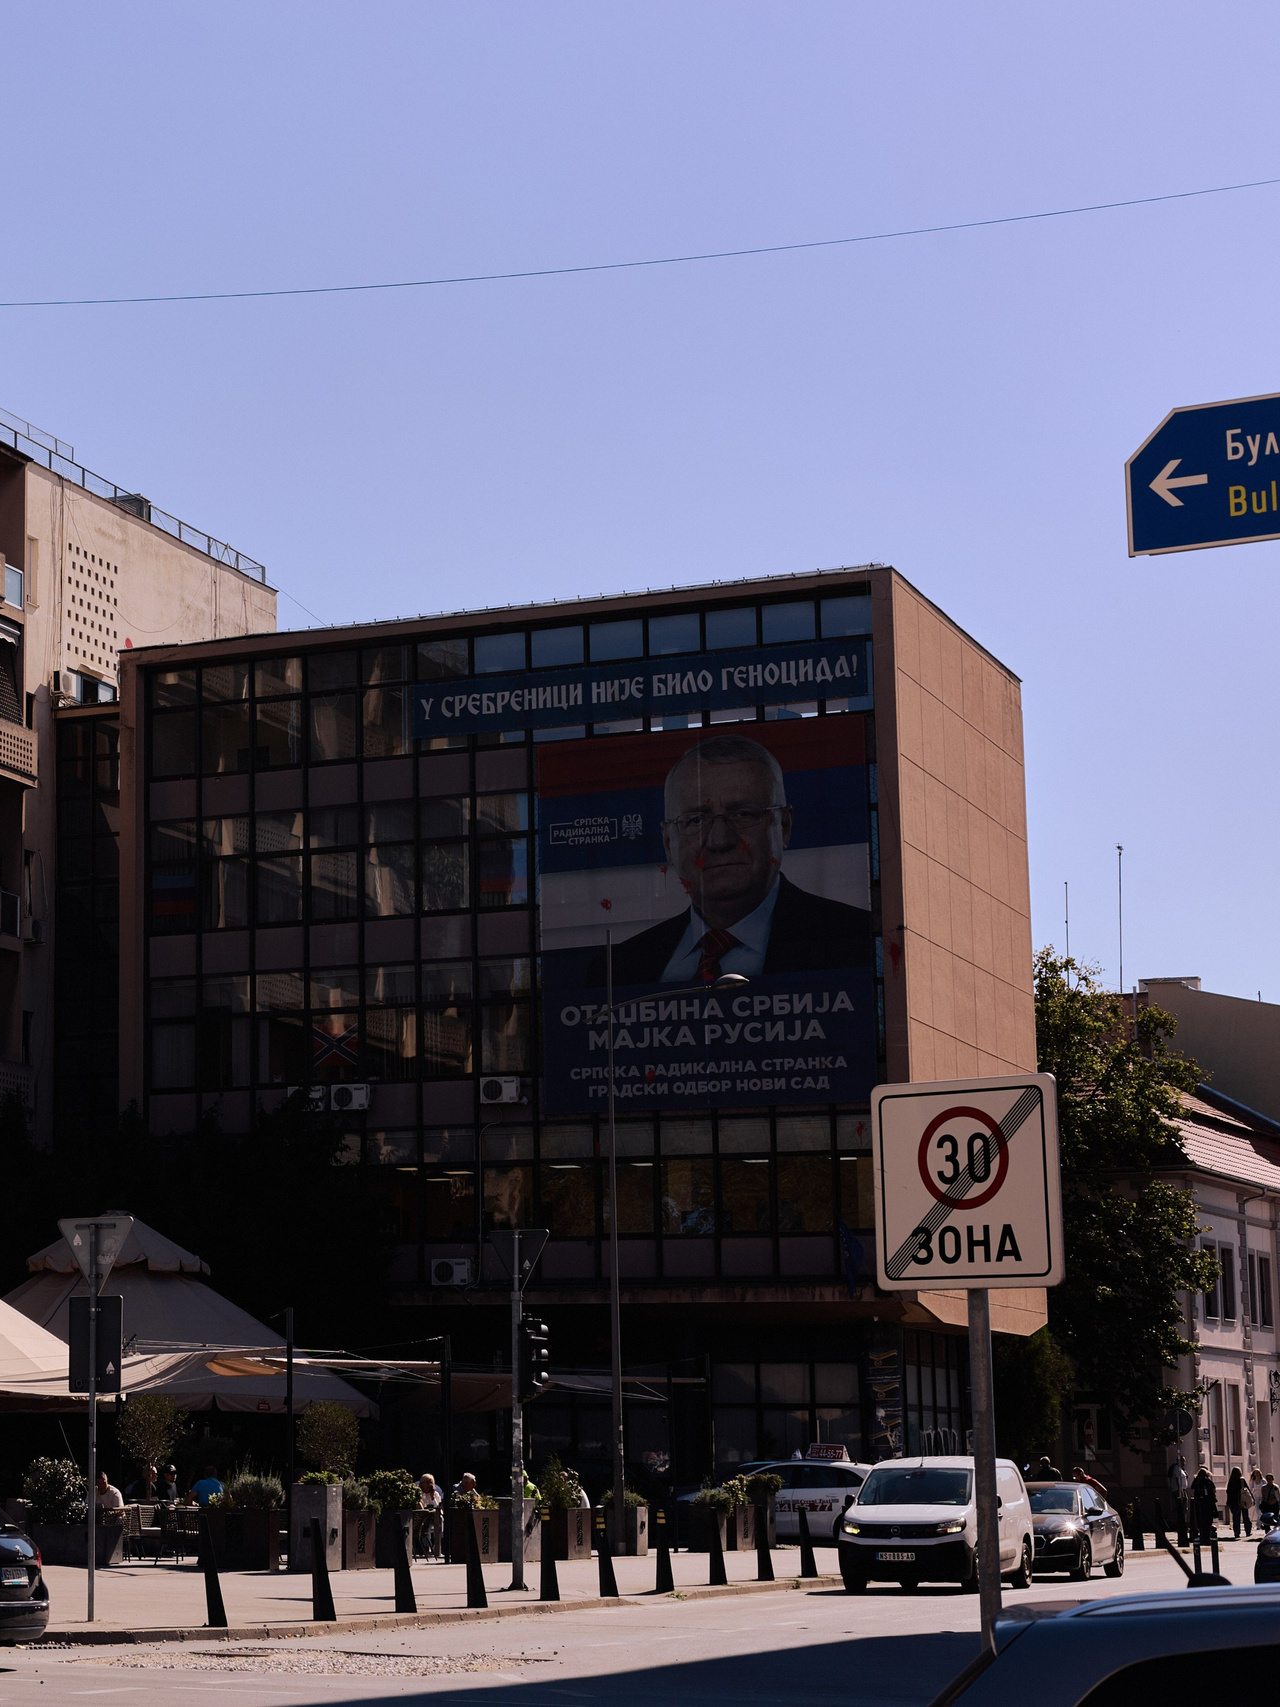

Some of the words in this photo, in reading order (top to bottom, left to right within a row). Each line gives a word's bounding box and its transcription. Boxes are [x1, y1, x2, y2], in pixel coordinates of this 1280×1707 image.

[1226, 428, 1279, 466] Бул
[1229, 480, 1277, 516] Bul
[421, 698, 433, 720] У
[441, 682, 582, 718] СРЕБРЕНИЦИ
[591, 676, 644, 704] НИЈЕ
[652, 669, 713, 697] БИЛО
[721, 654, 858, 691] ГЕНОЦИДА!
[553, 826, 610, 838] РАДИКАЛНА
[574, 817, 610, 827] СРПСКА
[568, 835, 610, 845] СТРАНКА
[560, 998, 724, 1026] ОТАЏБИНА
[732, 991, 855, 1017] СРБИЈА
[588, 1026, 696, 1051] МАЈКА
[704, 1019, 826, 1045] РУСИЈА
[570, 1065, 640, 1080] СРПСКА
[645, 1060, 757, 1077] РАДИКАЛНА
[761, 1056, 848, 1071] СТРАНКА
[588, 1082, 668, 1098] ГРАДСКИ
[672, 1080, 732, 1095] ОДБОР
[736, 1078, 786, 1092] НОВИ
[790, 1076, 830, 1090] САД
[937, 1132, 990, 1185] 30
[911, 1224, 1022, 1265] ЗОНА
